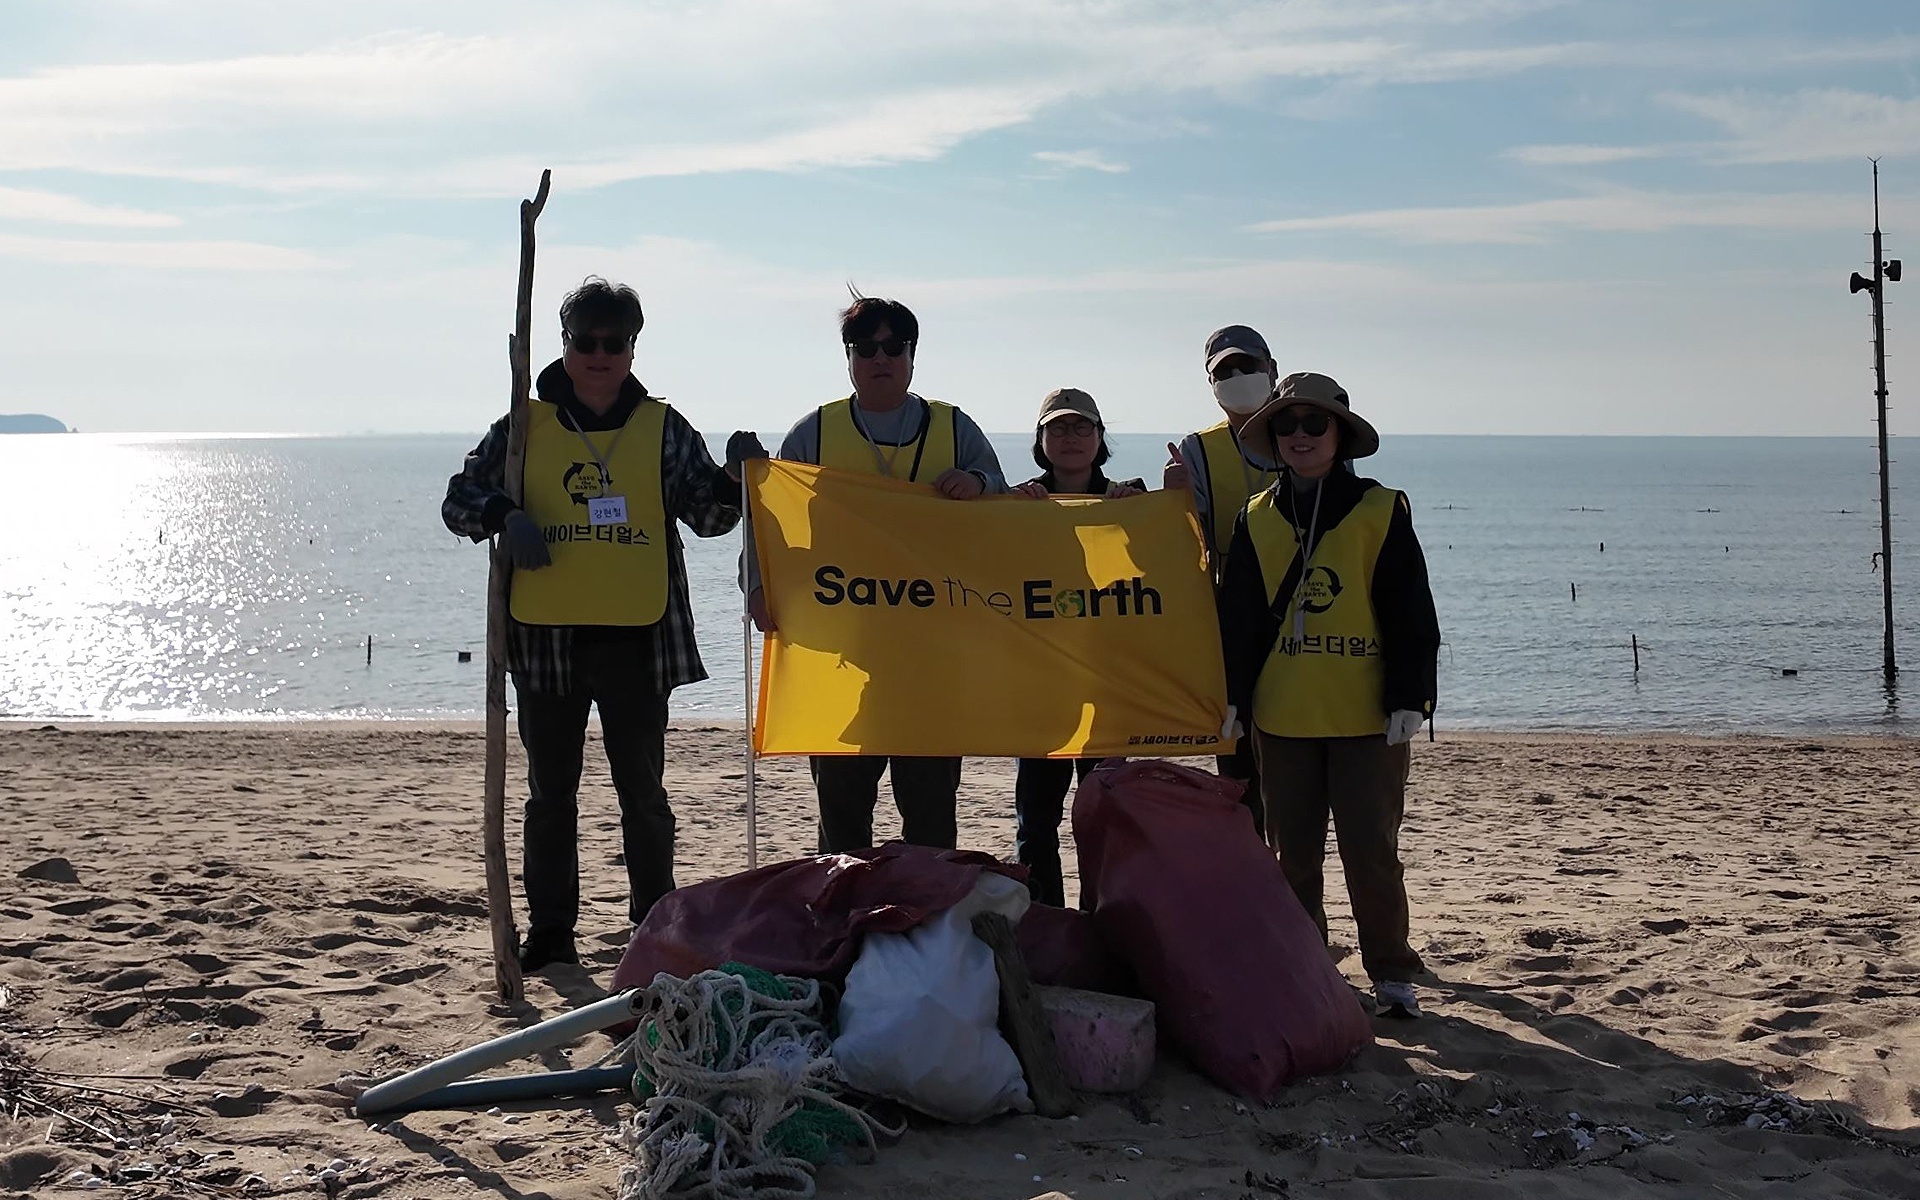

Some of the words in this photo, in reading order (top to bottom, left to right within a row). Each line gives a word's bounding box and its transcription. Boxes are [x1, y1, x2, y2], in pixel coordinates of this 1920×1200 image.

[596, 525, 612, 543] 더
[617, 526, 649, 545] 얼스
[813, 565, 935, 608] Save
[942, 575, 1013, 616] the
[1023, 577, 1163, 620] Earth
[1326, 635, 1345, 656] 더
[1348, 637, 1379, 656] 얼스
